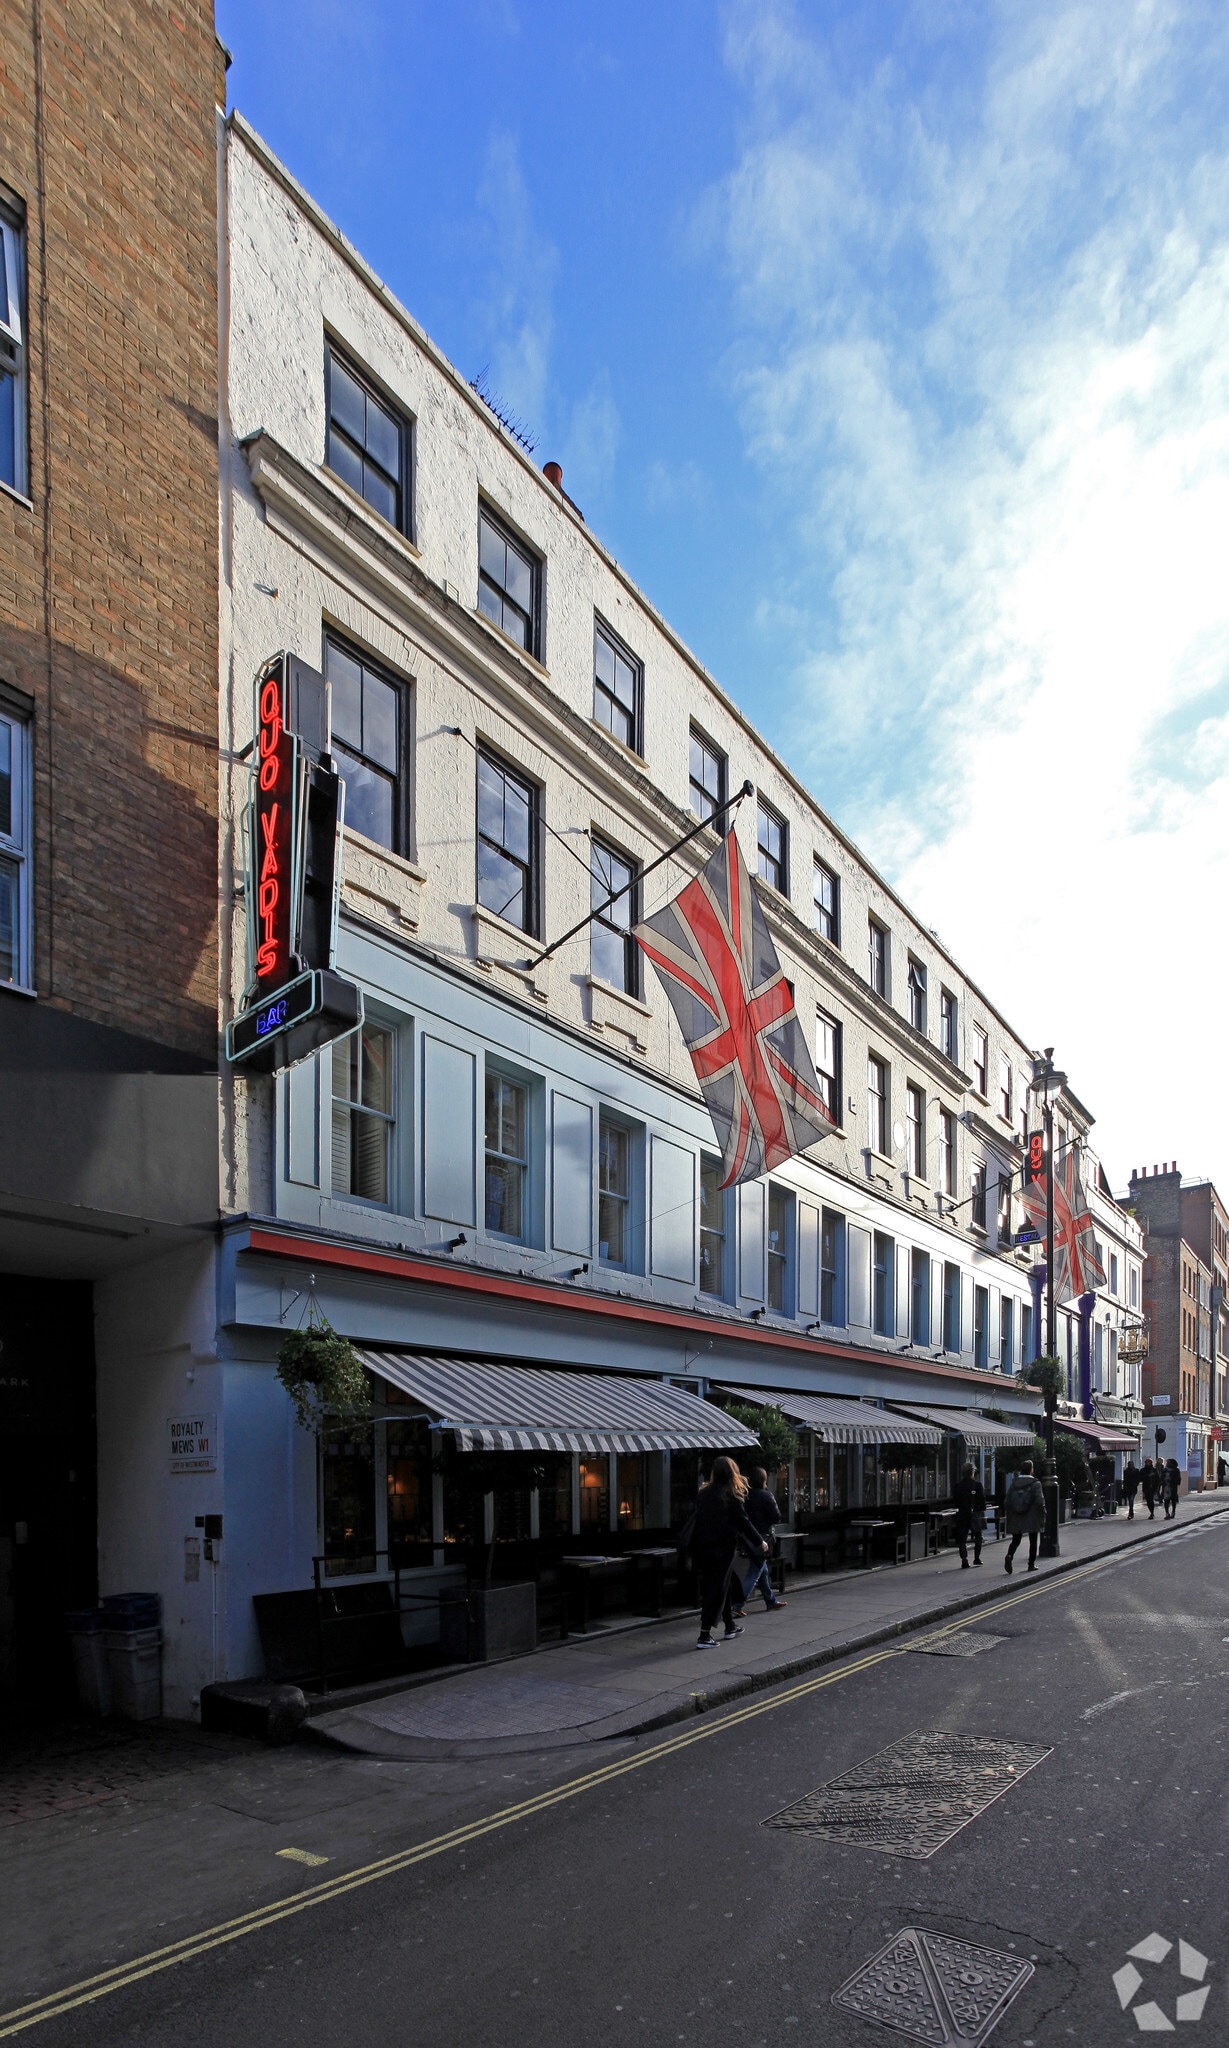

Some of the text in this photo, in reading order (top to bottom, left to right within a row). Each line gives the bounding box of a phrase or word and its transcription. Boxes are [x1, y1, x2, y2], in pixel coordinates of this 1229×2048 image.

[257, 680, 282, 977] QUO VADIS
[256, 1000, 287, 1034] BAR
[0, 1377, 30, 1387] ARK
[171, 1421, 204, 1437] ROYALTY
[172, 1438, 209, 1454] MEWS W1
